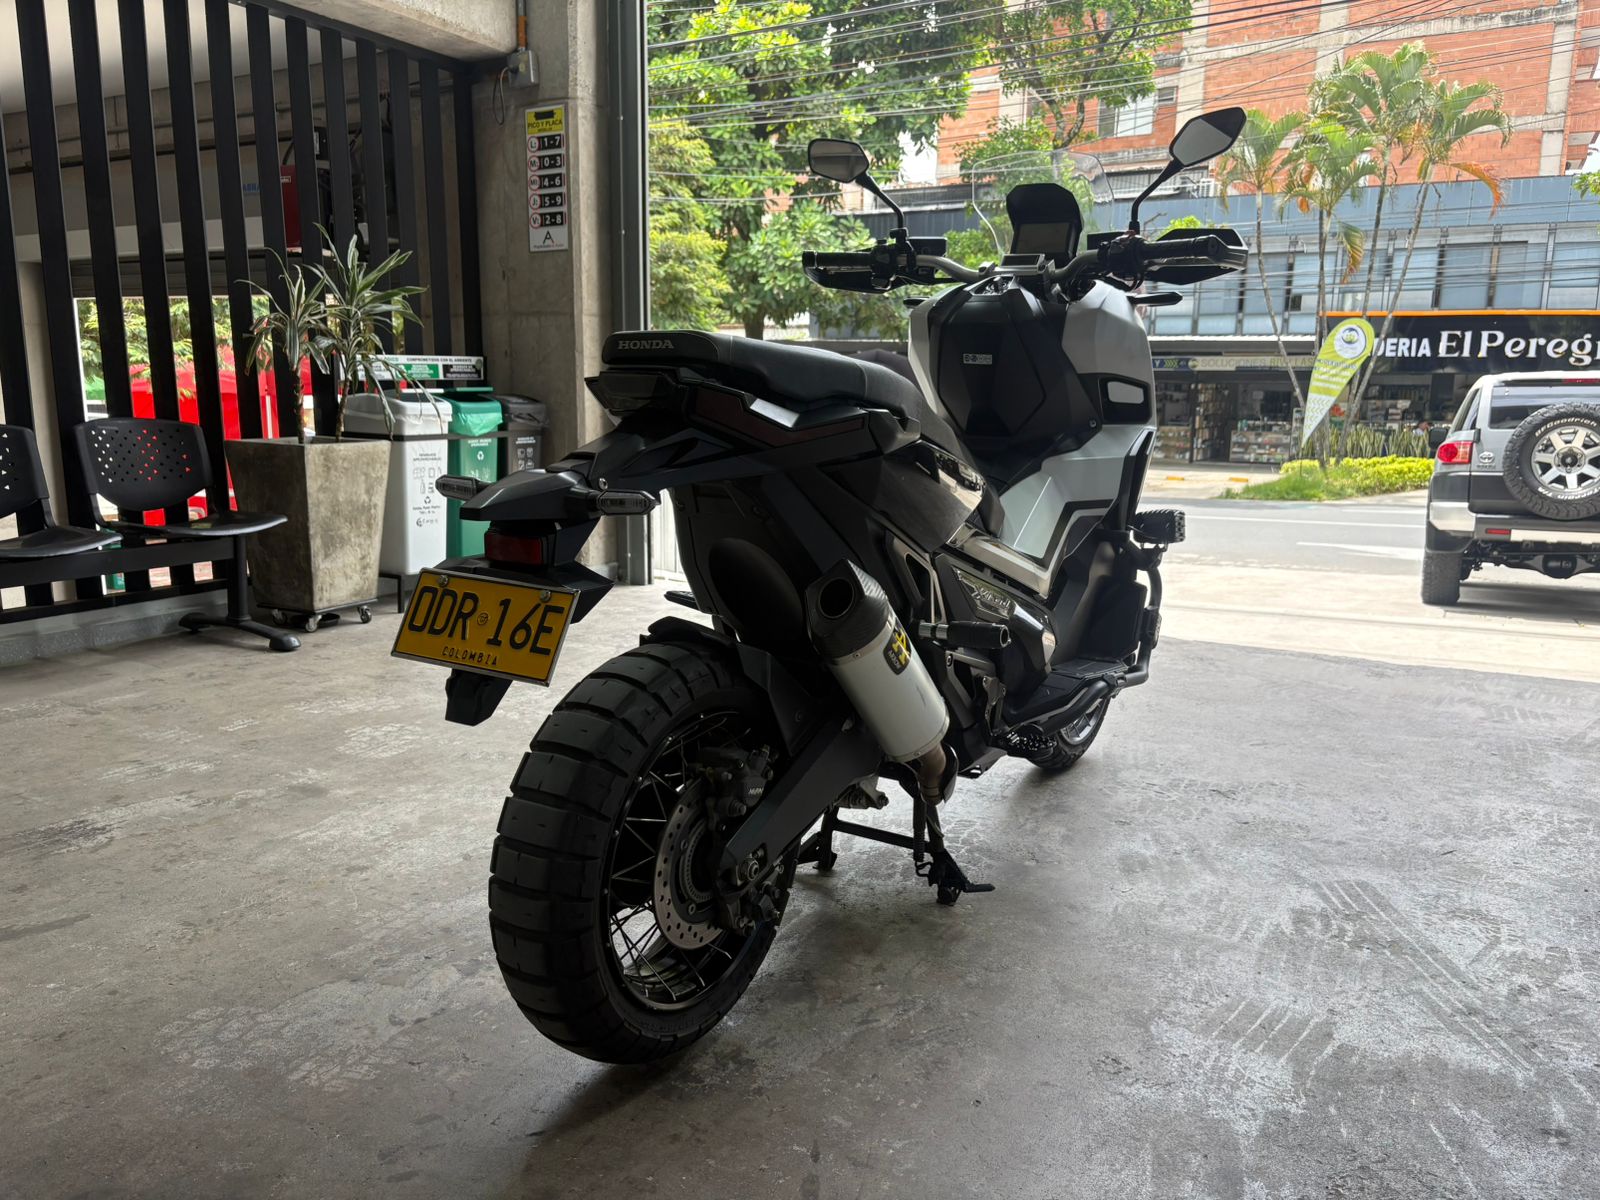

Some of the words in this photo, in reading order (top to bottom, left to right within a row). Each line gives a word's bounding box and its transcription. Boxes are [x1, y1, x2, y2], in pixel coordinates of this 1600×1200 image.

[545, 119, 563, 127] PLACA
[617, 339, 674, 349] HONDA
[1437, 330, 1474, 358] El
[486, 598, 565, 656] 16E
[442, 645, 498, 666] COLOMBIA
